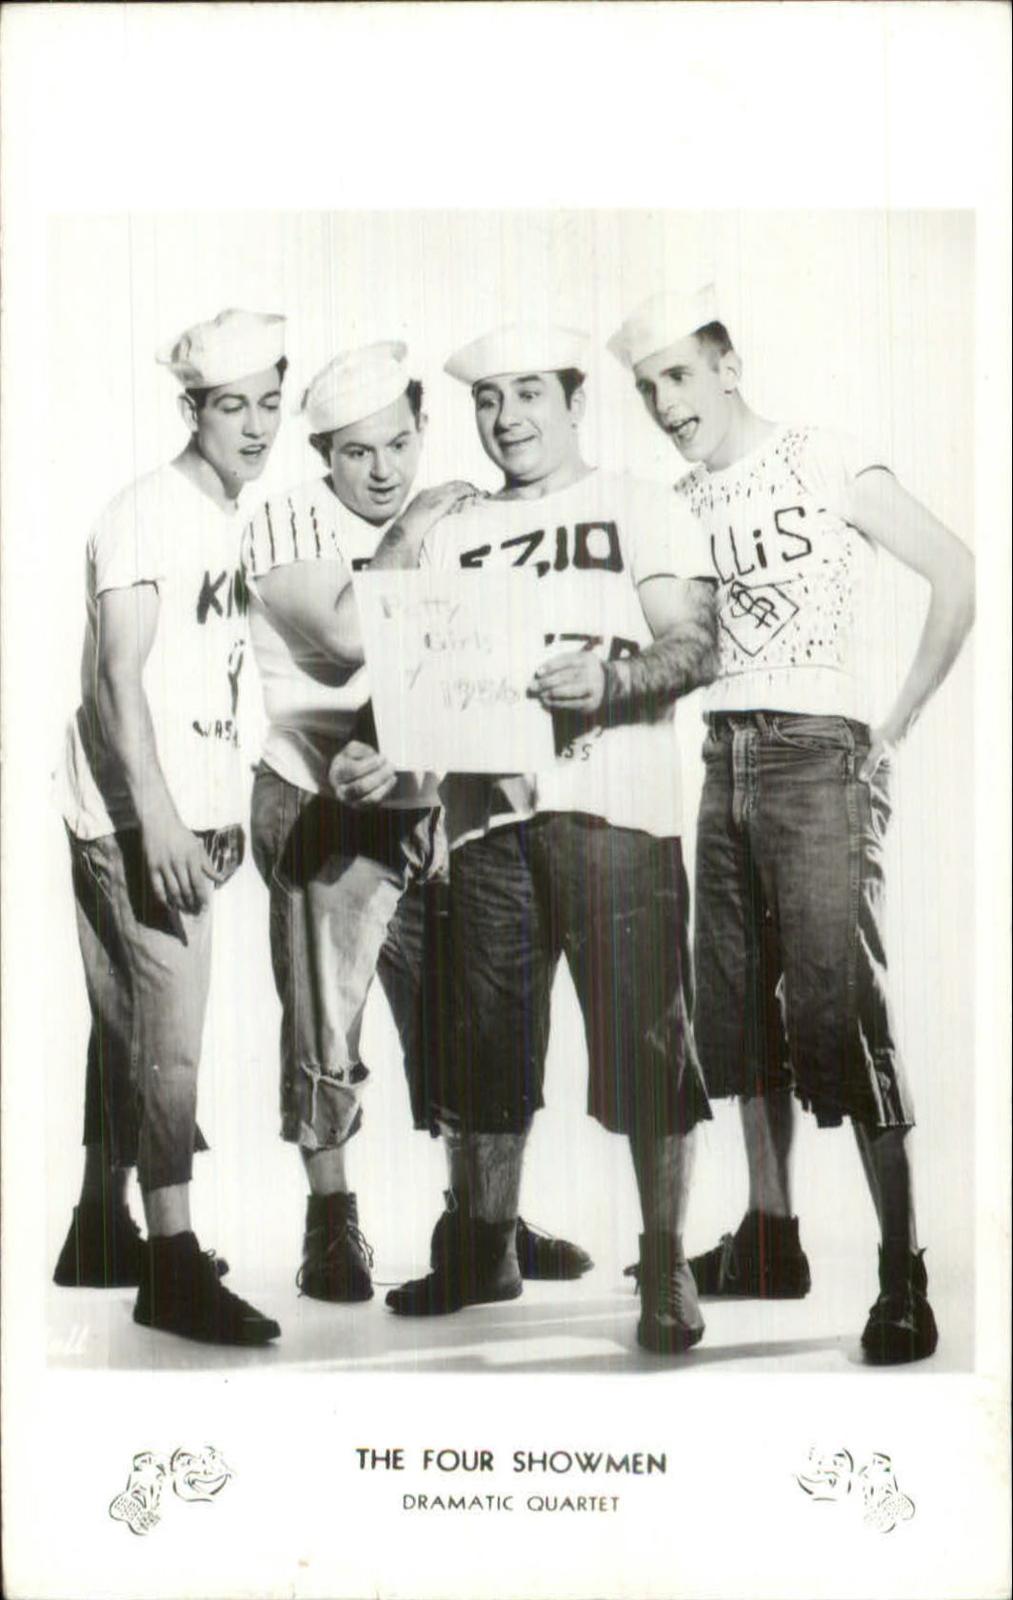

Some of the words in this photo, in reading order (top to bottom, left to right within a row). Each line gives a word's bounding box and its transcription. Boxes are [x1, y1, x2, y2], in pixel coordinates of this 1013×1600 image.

[356, 1448, 405, 1471] THE
[423, 1449, 494, 1472] FOUR
[513, 1451, 667, 1475] SHOWMEN
[402, 1494, 514, 1511] DRAMATIC
[526, 1496, 620, 1512] QUARTET
